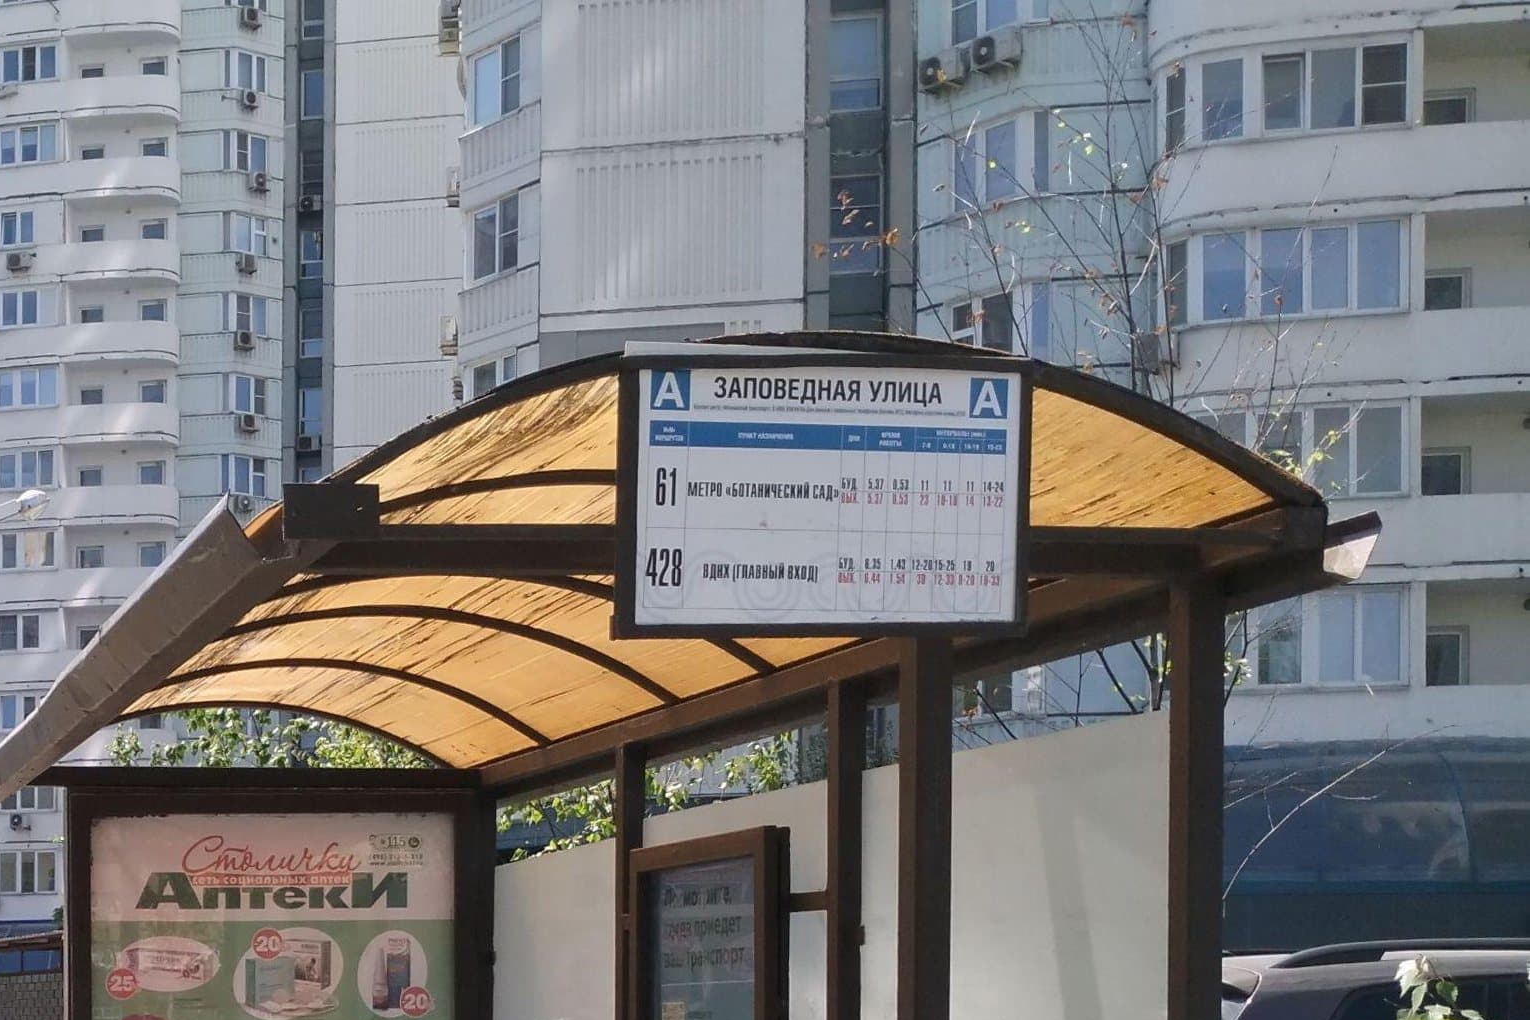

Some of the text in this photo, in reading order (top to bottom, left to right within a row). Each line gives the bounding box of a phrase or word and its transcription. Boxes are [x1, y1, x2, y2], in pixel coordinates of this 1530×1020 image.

[714, 377, 942, 407] ЗАПОВЕДНАЯ УЛИЦА
[655, 467, 677, 507] 61
[688, 482, 839, 501] МЕТРО «БОТАНИЧЕСКИЙ САД»
[921, 480, 929, 491] 11
[943, 480, 952, 491] 11
[966, 481, 974, 492] 11
[645, 547, 682, 587] 428
[703, 563, 818, 584] ВДНХ (ГЛАВНЫЙ ВХОД)
[182, 835, 361, 873] Столички
[193, 875, 351, 888] сеть социальных аптек
[694, 916, 742, 940] приедет
